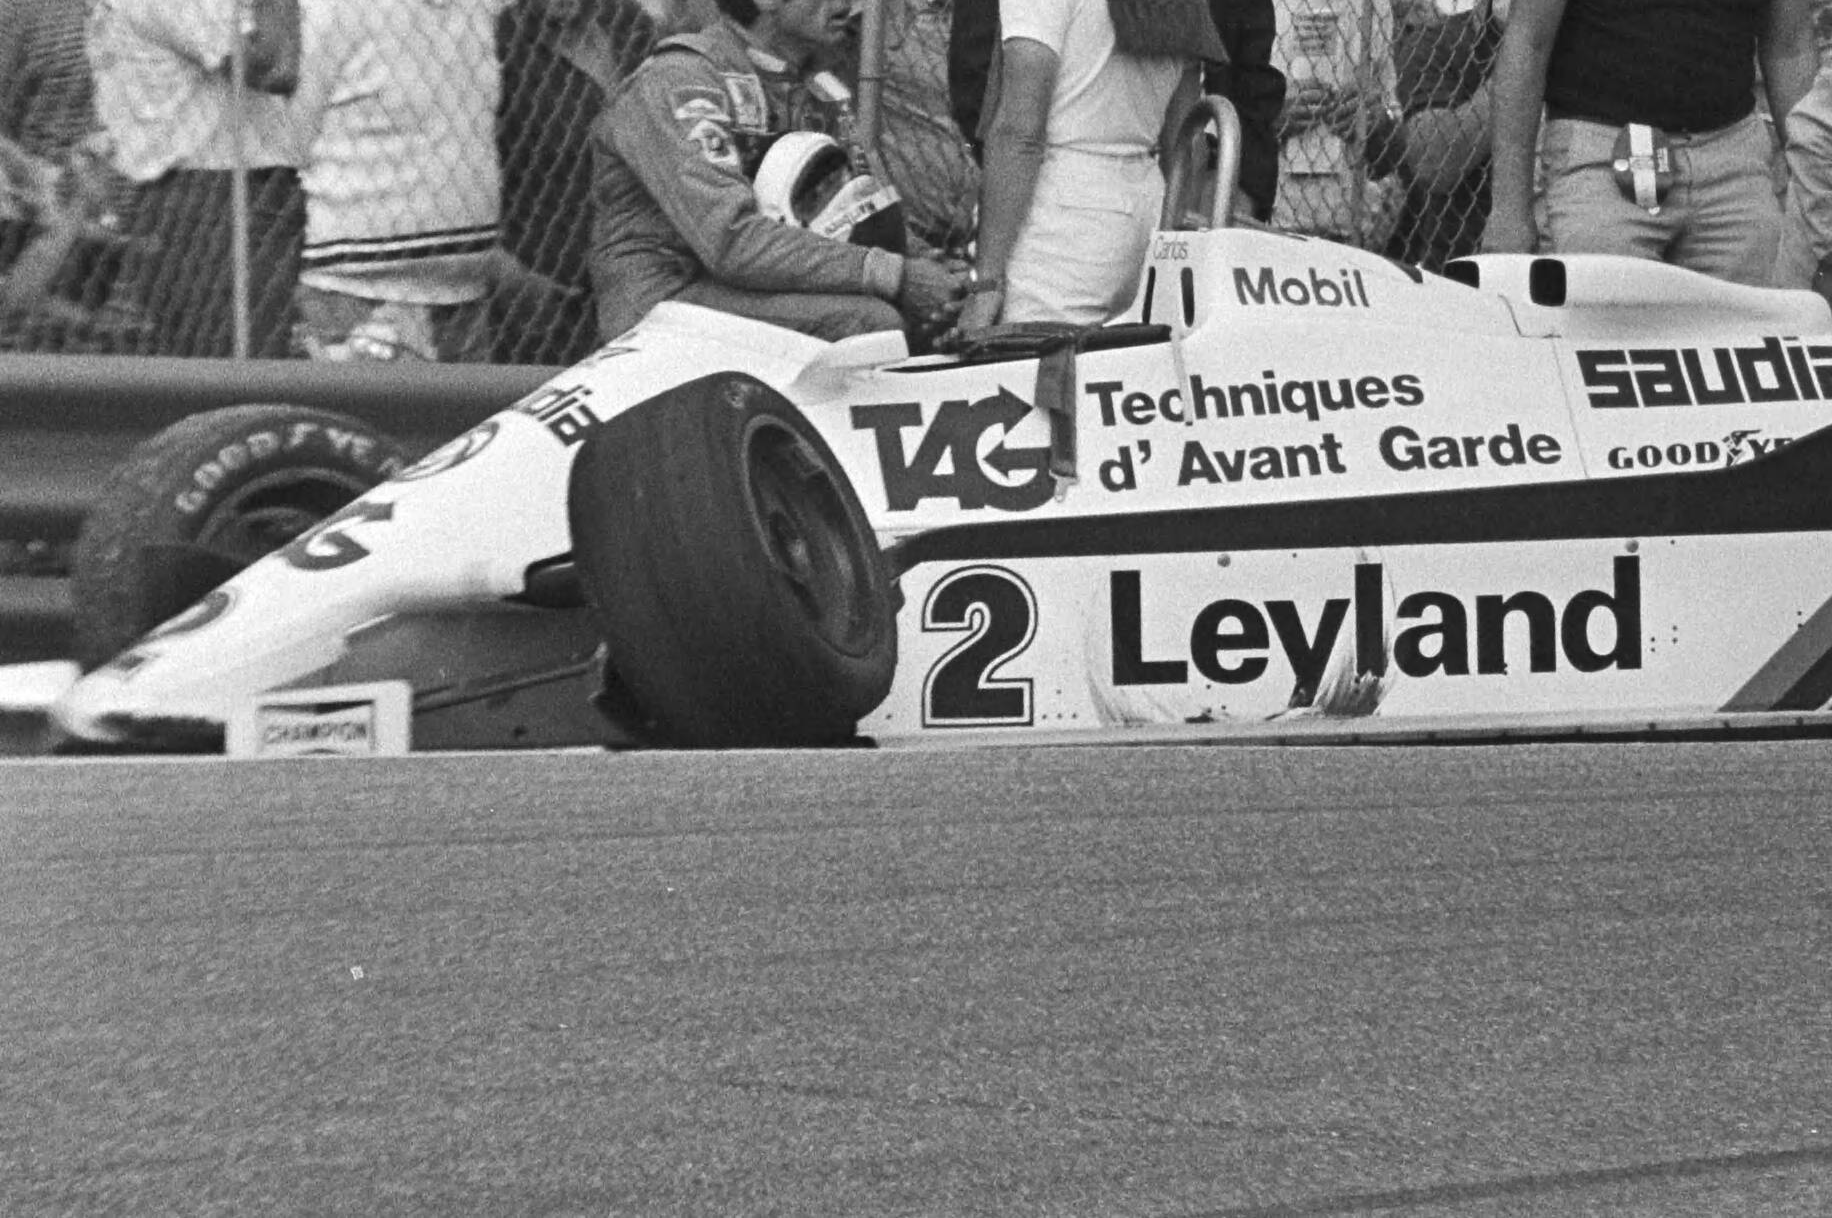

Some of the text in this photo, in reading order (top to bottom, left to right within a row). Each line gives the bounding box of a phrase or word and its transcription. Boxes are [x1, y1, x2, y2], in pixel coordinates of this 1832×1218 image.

[1233, 267, 1370, 307] Mobil
[1086, 370, 1424, 426] Techniques
[850, 384, 1058, 512] TAG
[1178, 433, 1347, 486] Avant
[1379, 424, 1562, 471] Garde
[921, 555, 1643, 728] 2 Leyland
